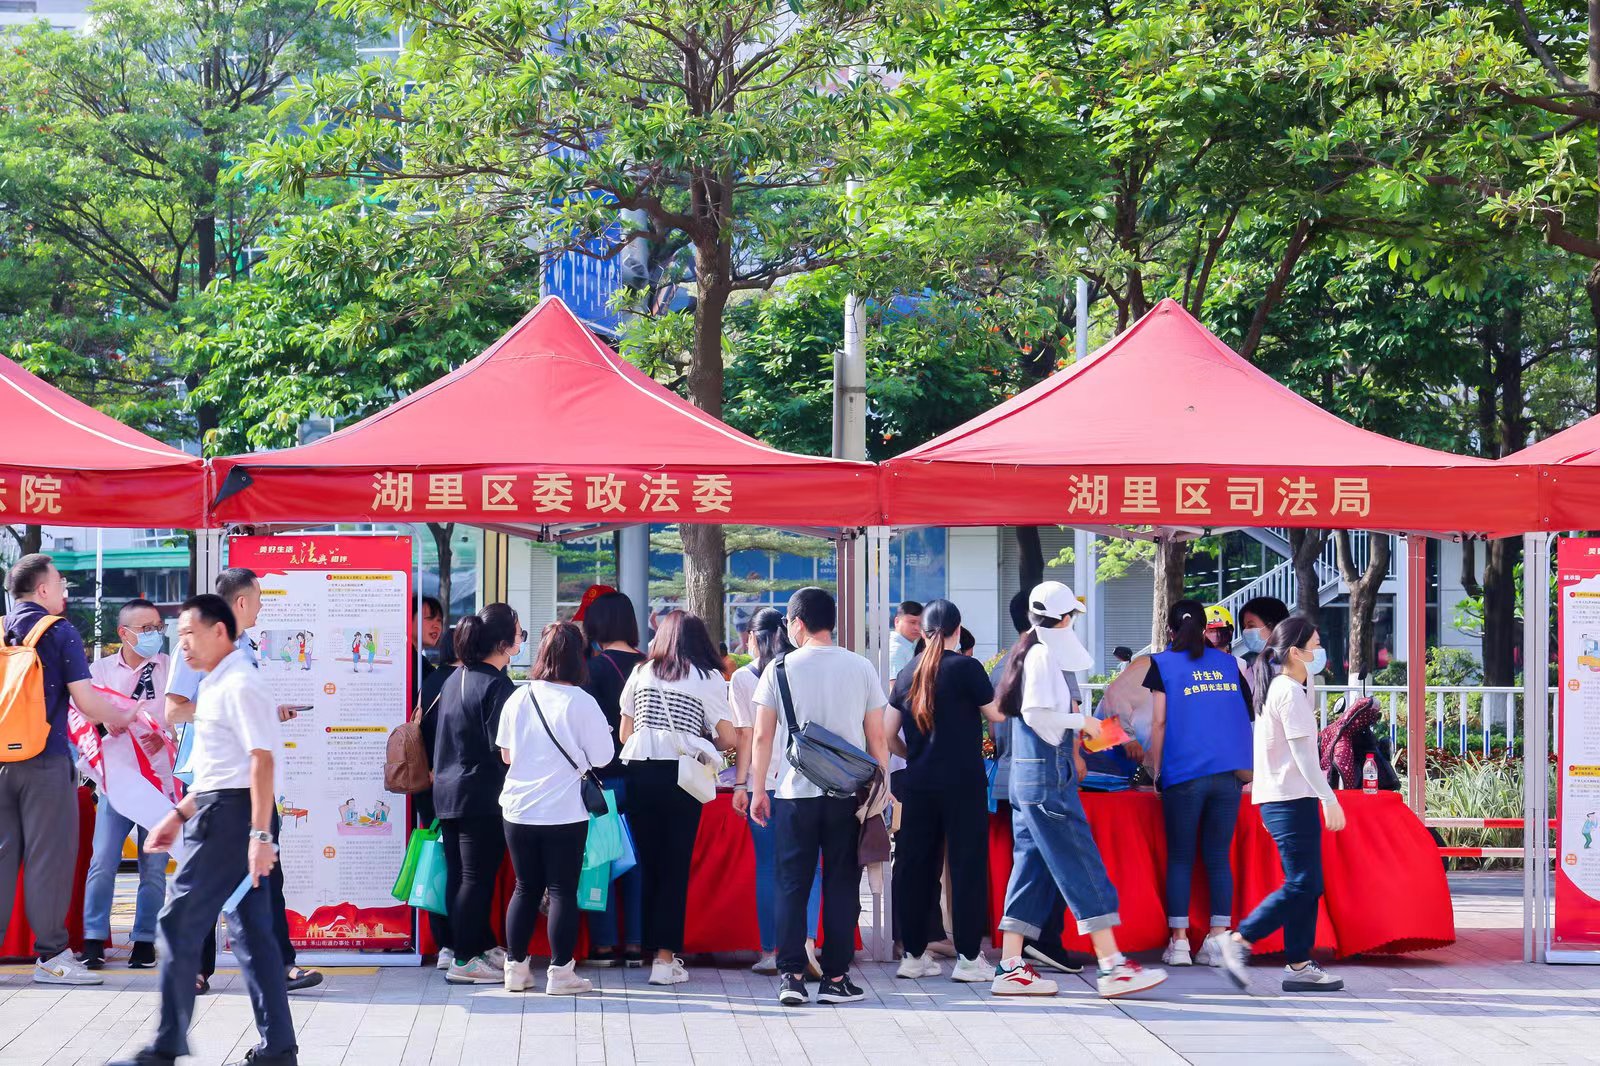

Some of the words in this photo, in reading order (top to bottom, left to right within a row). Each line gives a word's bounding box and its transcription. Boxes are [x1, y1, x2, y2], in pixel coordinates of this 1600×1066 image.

[371, 471, 733, 514] 湖里区委政法委
[1067, 473, 1371, 518] 湖里区司法局
[259, 545, 293, 553] 美好生活
[1192, 670, 1223, 681] 计生协
[1184, 682, 1238, 695] 金色阳光志愿者
